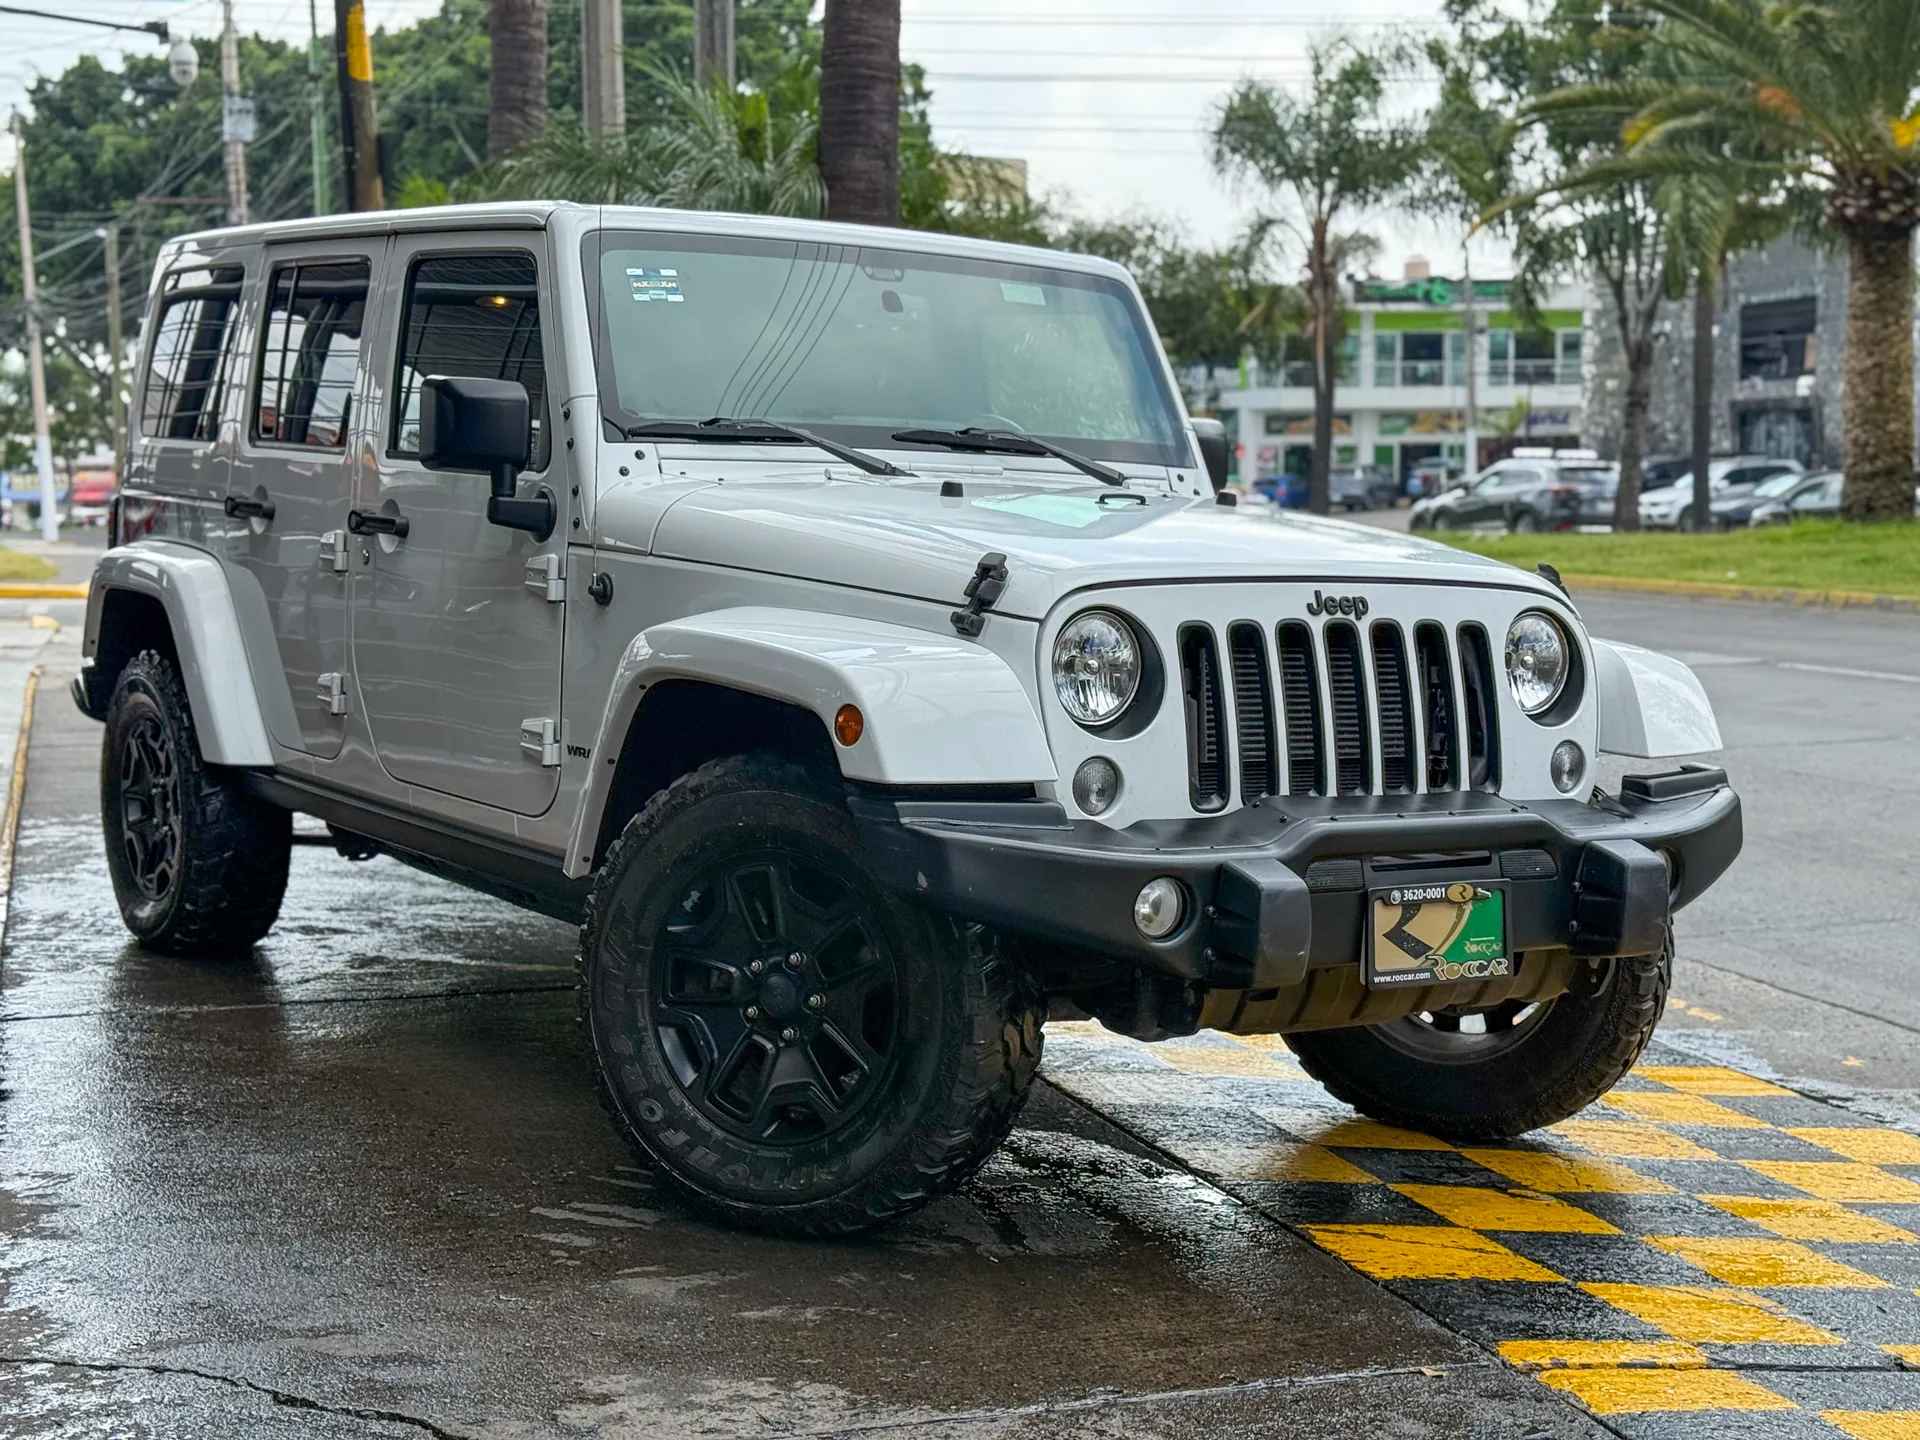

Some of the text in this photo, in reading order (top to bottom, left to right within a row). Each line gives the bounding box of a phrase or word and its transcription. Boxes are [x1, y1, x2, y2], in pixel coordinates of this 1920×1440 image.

[1307, 590, 1368, 621] Jeep
[1403, 888, 1445, 900] 3620-0001
[1374, 972, 1430, 983] www.roccar.com
[1426, 956, 1508, 981] ROCCAR
